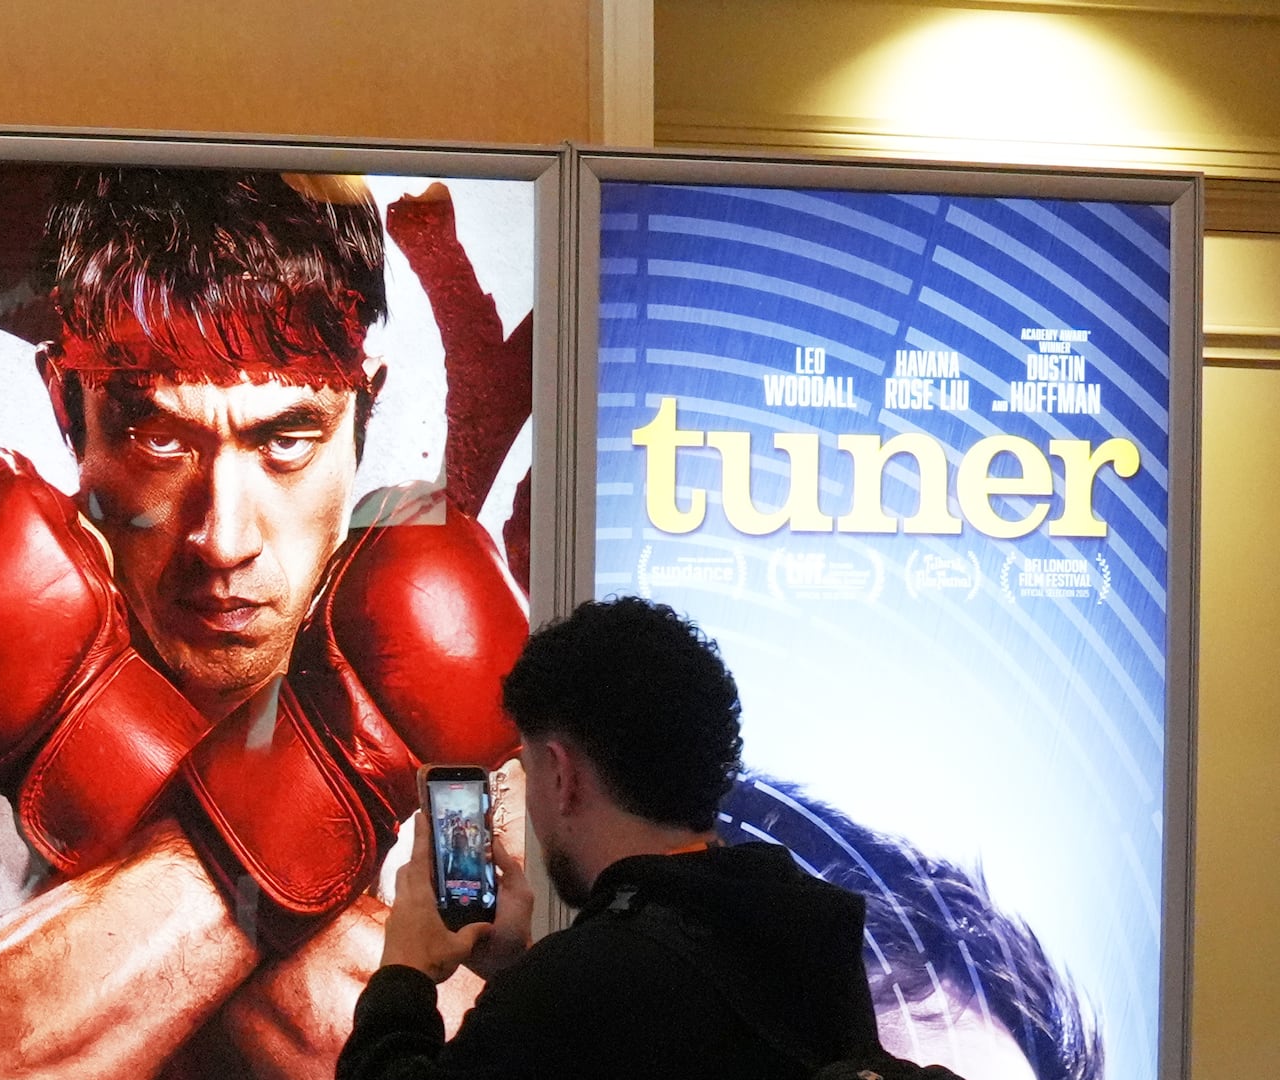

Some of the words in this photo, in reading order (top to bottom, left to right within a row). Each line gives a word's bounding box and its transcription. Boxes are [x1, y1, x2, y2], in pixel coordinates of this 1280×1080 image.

[1021, 328, 1058, 341] ACADEMY
[1038, 341, 1071, 354] WINNER
[795, 346, 826, 375] LEO
[895, 349, 961, 378] HAVANA
[1026, 354, 1086, 382] DUSTIN
[763, 374, 857, 408] WOODALL
[884, 378, 934, 410] ROSE
[939, 380, 970, 411] LIU
[992, 400, 1009, 412] AND
[1010, 381, 1101, 414] HOFFMAN
[631, 397, 1141, 539] tuner
[1018, 572, 1044, 587] FILM
[1046, 573, 1092, 588] FESTIVAL
[1024, 558, 1042, 572] BFI
[1043, 558, 1088, 573] LONDON
